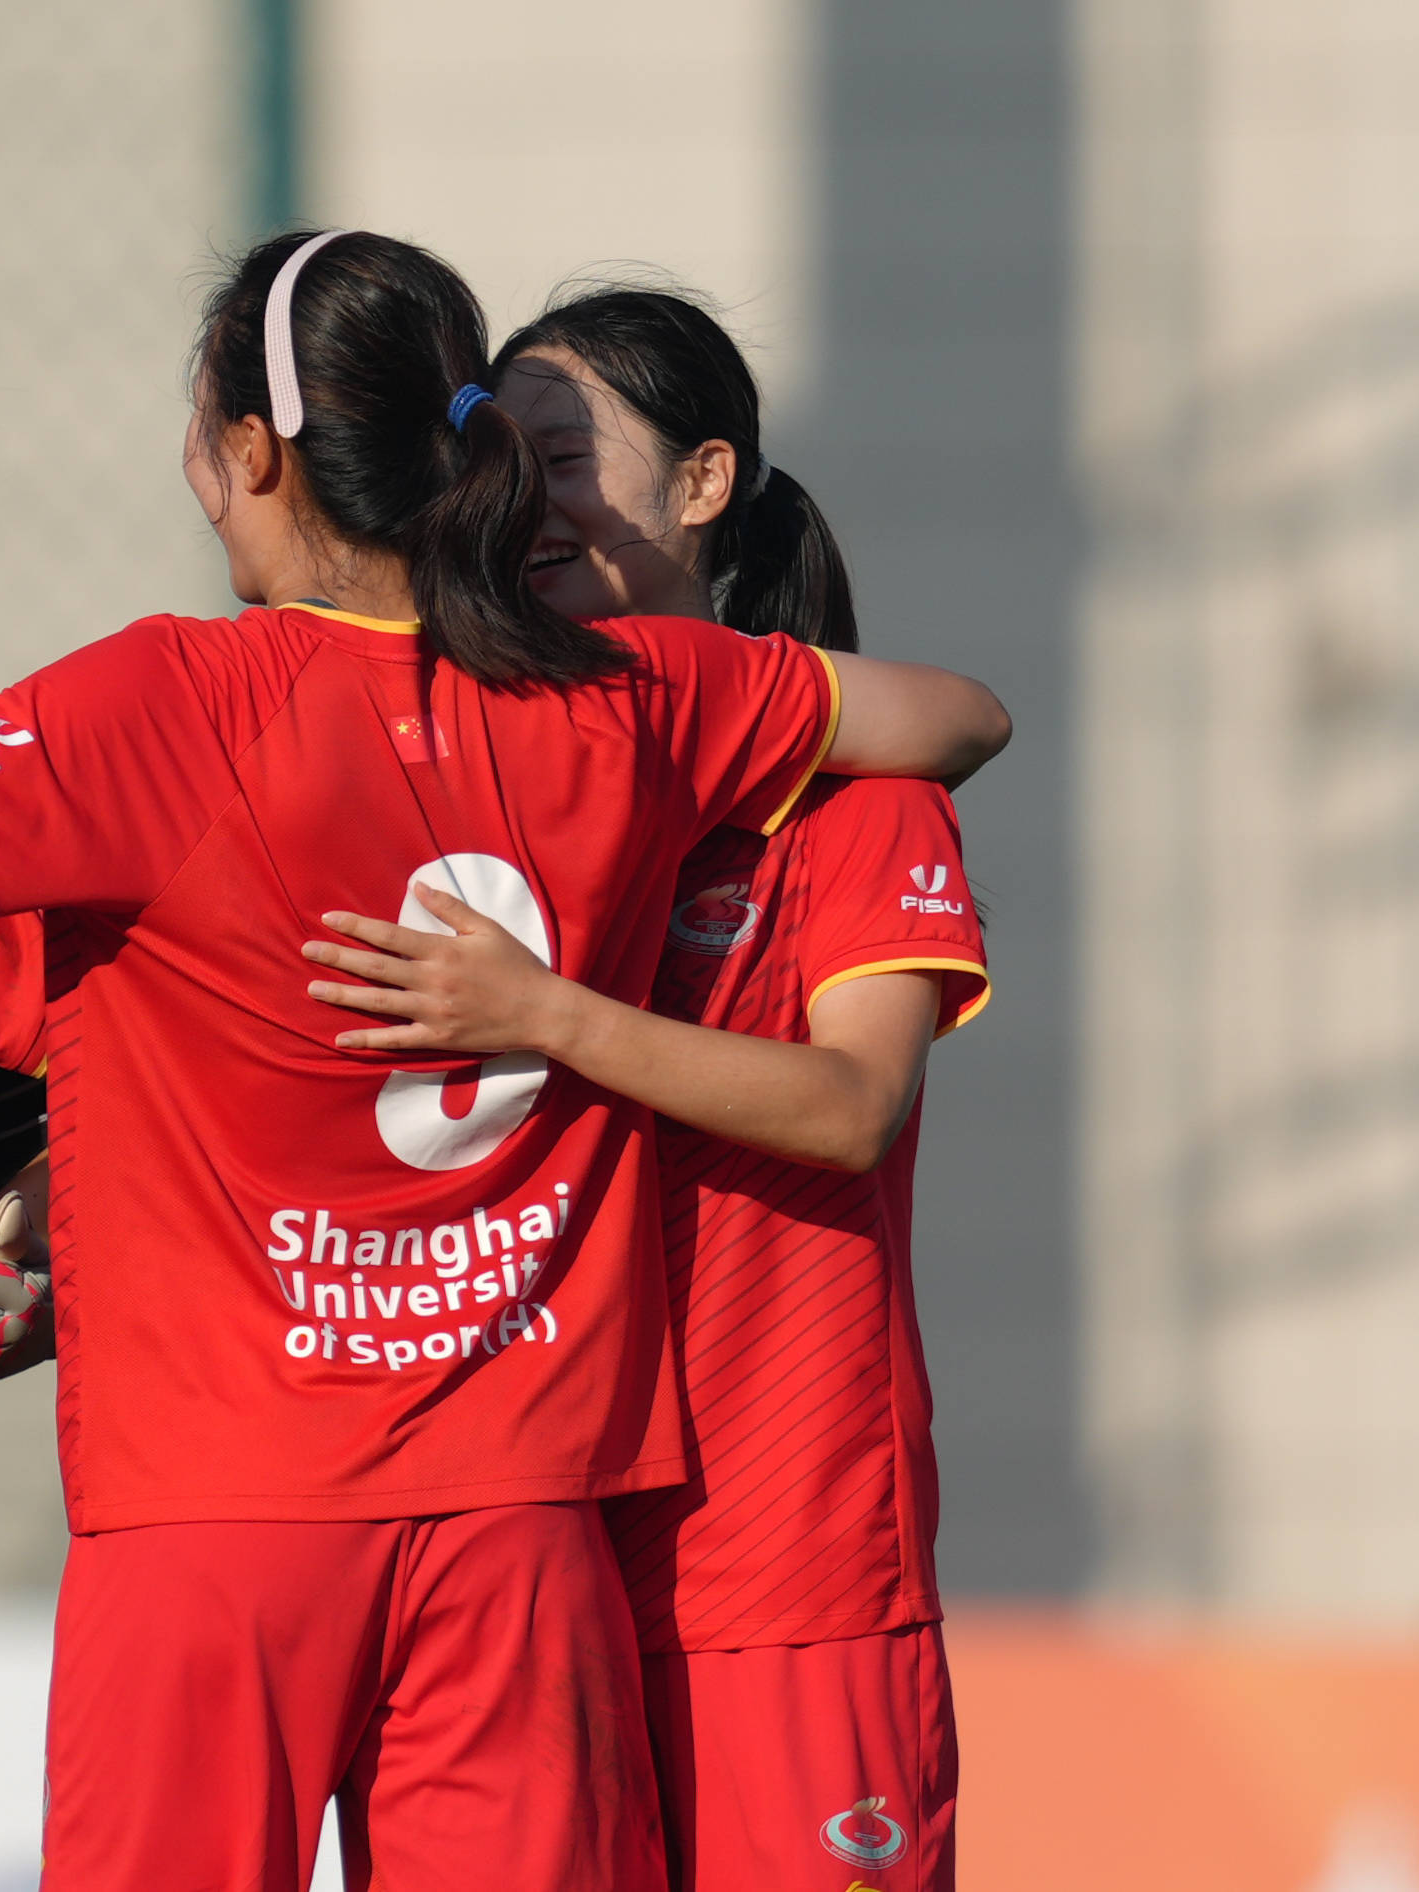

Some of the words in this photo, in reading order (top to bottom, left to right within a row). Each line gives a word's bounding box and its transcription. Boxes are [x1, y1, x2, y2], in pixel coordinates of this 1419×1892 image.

[900, 895, 963, 915] FISU
[267, 1182, 570, 1278] Shanghai
[271, 1253, 551, 1321] Universit
[285, 1322, 339, 1361] of
[347, 1303, 559, 1372] spor(H)
